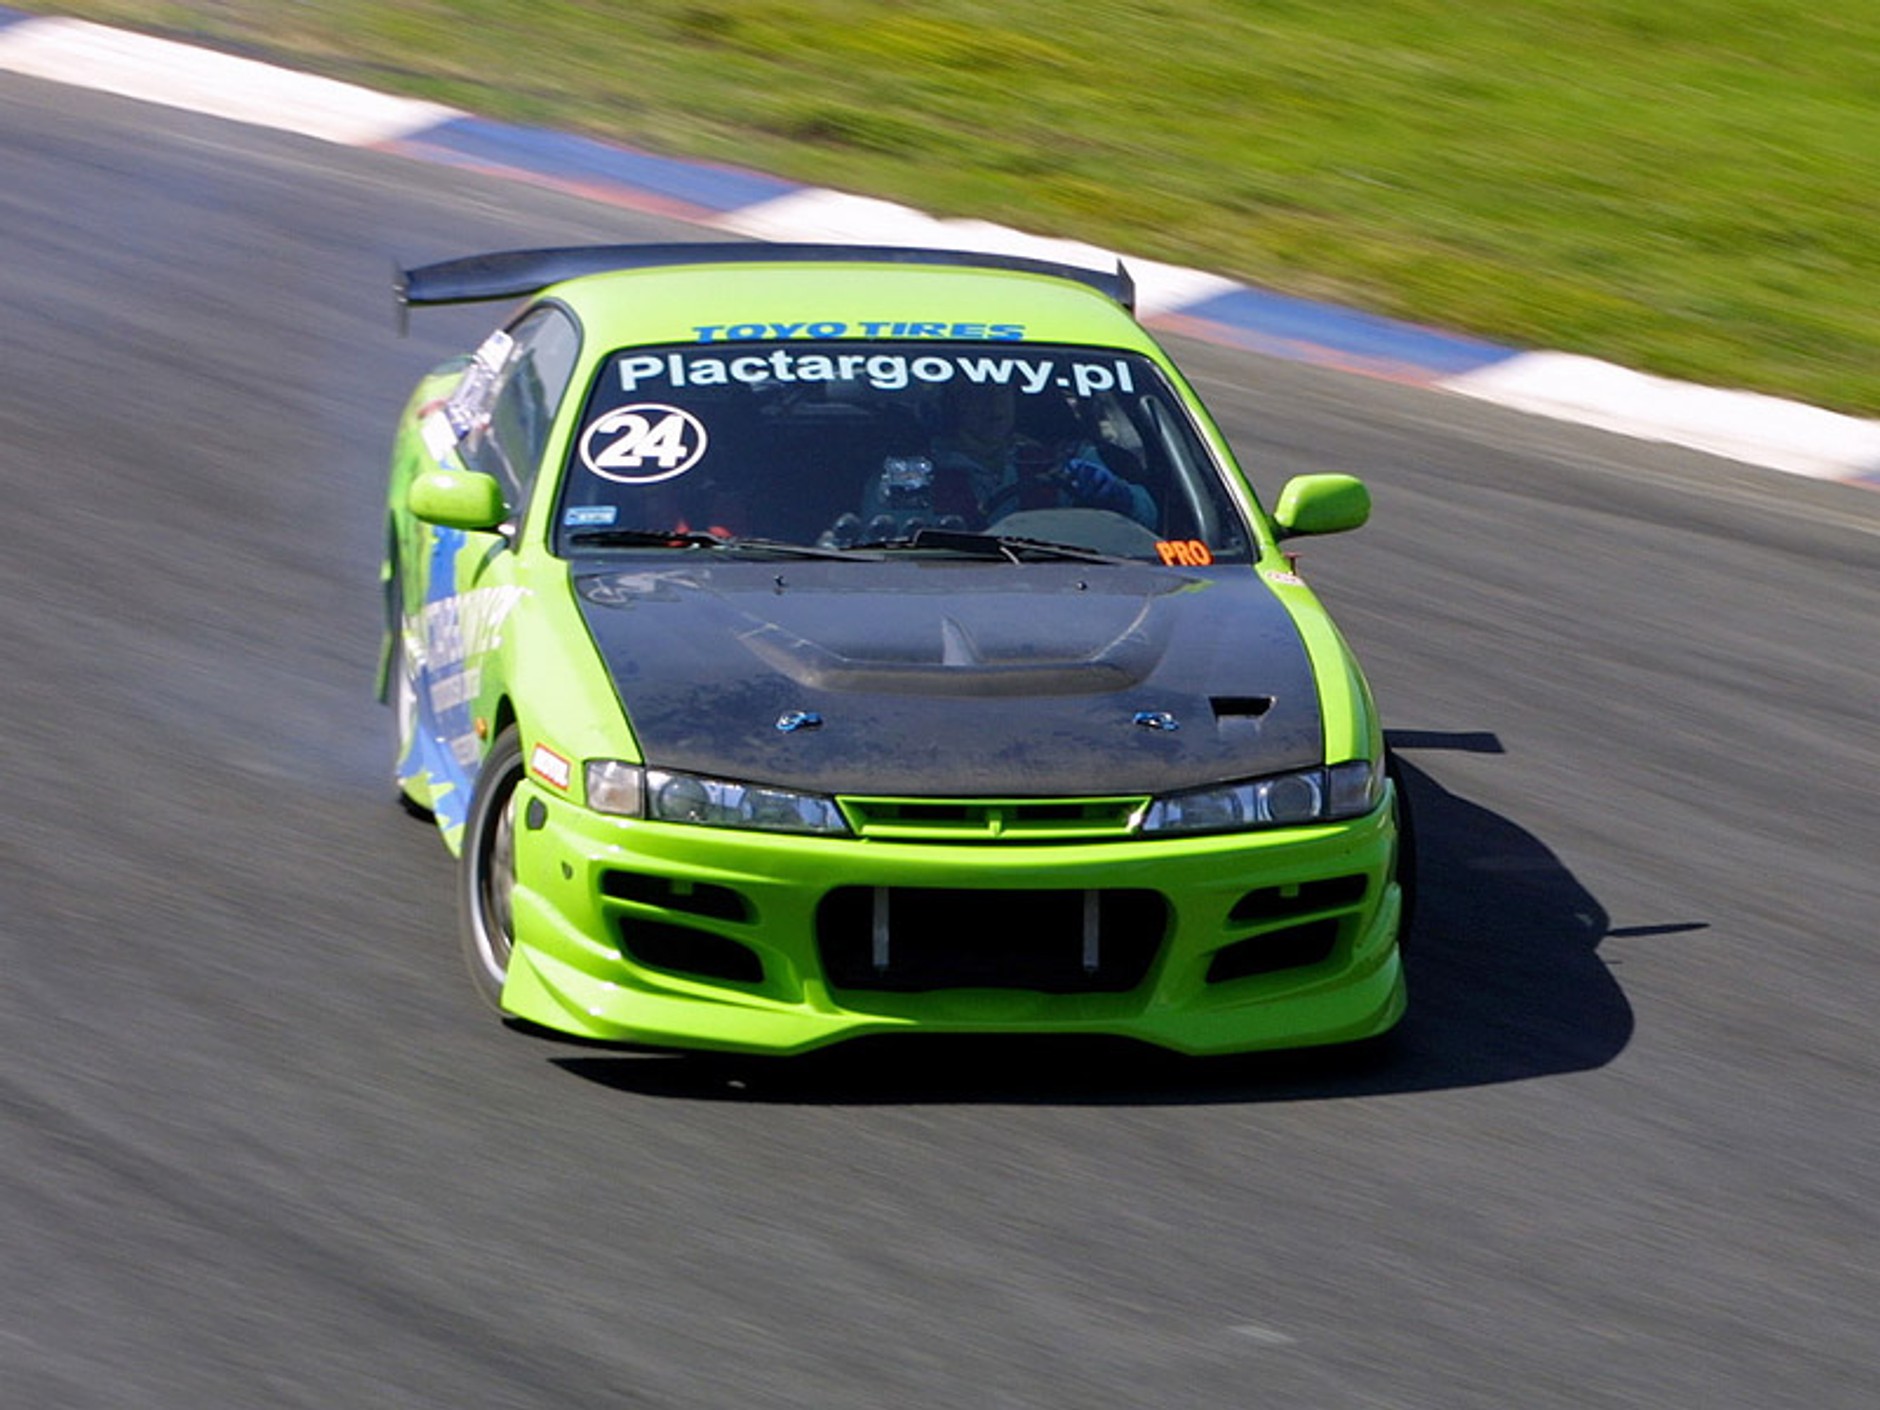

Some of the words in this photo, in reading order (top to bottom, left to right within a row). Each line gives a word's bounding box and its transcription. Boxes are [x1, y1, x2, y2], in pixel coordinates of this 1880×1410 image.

[692, 322, 847, 343] TOYO
[858, 322, 1026, 342] TIRES
[619, 349, 1133, 396] Plactargowy.pl
[596, 413, 688, 468] 24
[1155, 540, 1214, 566] PRO
